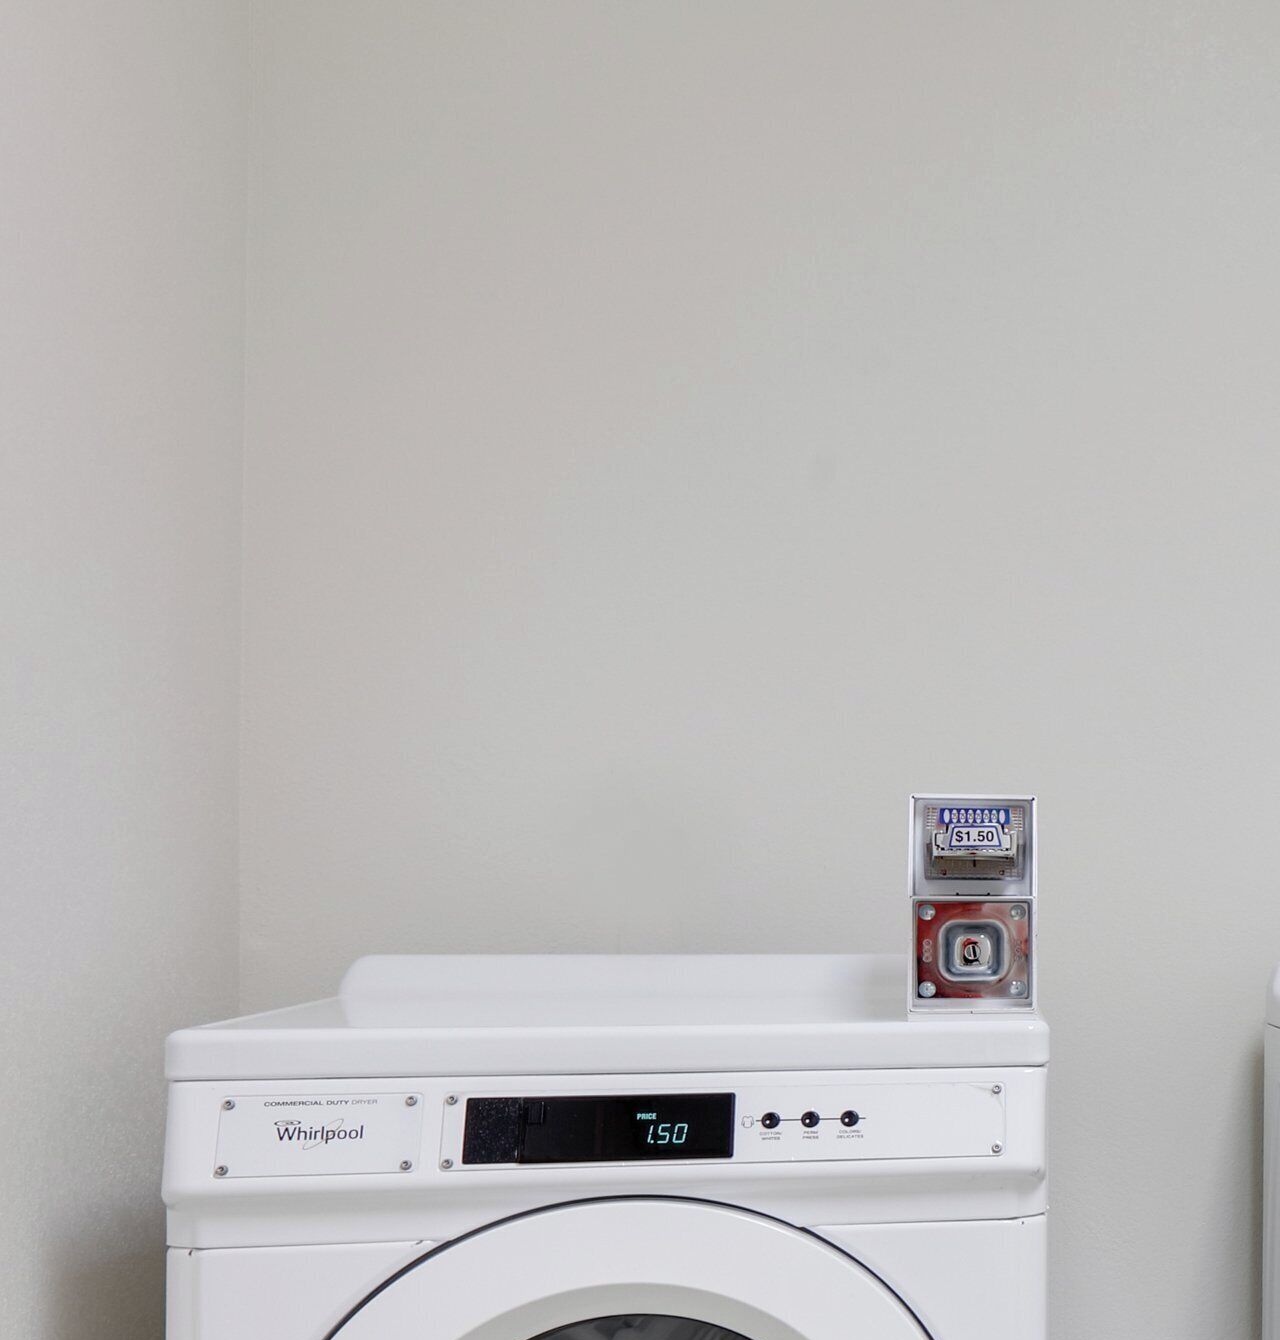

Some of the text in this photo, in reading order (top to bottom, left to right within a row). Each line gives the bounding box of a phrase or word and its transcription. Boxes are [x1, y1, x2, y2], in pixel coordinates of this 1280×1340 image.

[955, 830, 995, 843] $1.50
[636, 1112, 657, 1120] PRICE
[277, 1125, 364, 1144] Whirlpool
[647, 1123, 688, 1144] 1.50
